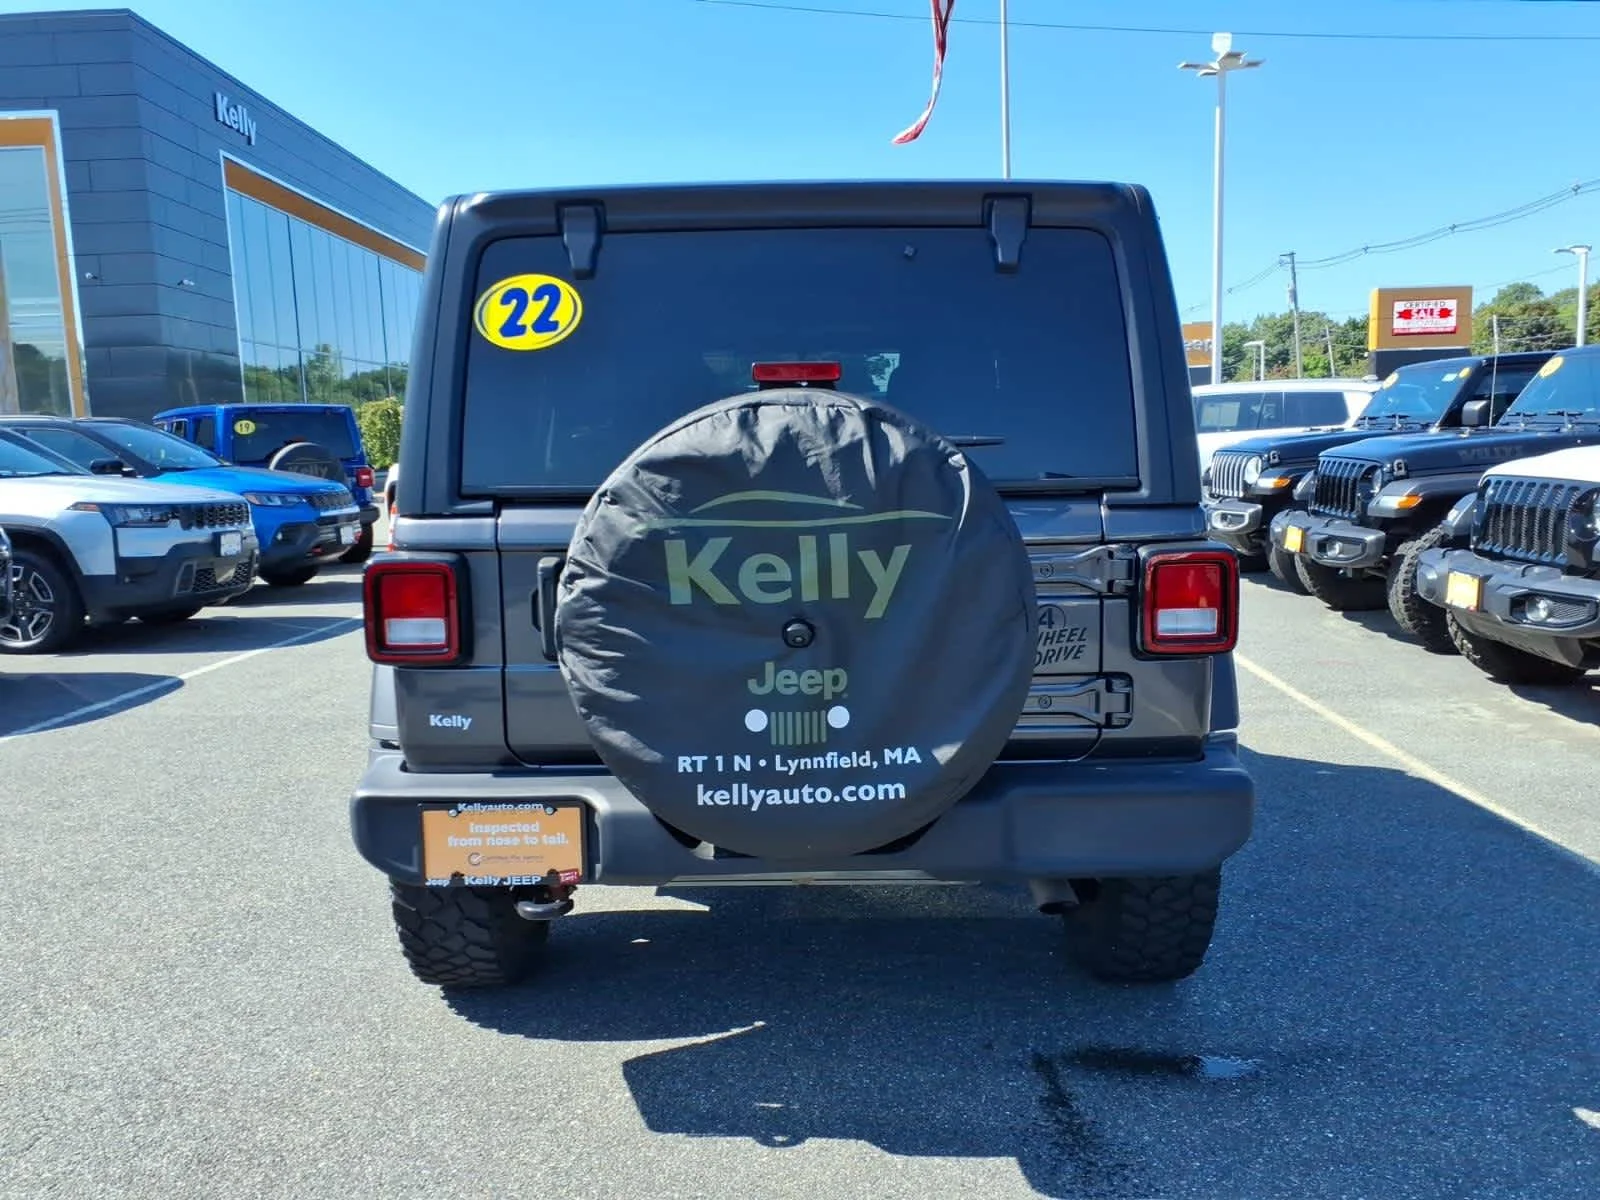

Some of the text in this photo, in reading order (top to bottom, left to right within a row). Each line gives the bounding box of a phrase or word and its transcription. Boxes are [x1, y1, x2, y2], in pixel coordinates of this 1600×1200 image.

[214, 91, 257, 146] Kelly
[499, 283, 562, 338] 22
[1411, 308, 1440, 319] SALE
[664, 532, 912, 619] Kelly
[747, 661, 848, 700] Jeep
[429, 714, 472, 731] Kelly
[677, 746, 922, 776] RT 1 N Lynnfield, MA
[457, 803, 544, 812] Kellyauto.com
[696, 782, 906, 812] kellyauto.com
[448, 837, 482, 847] from
[486, 836, 521, 847] nose
[523, 836, 539, 846] to
[464, 875, 501, 886] Kelly
[503, 875, 542, 885] JEEP
